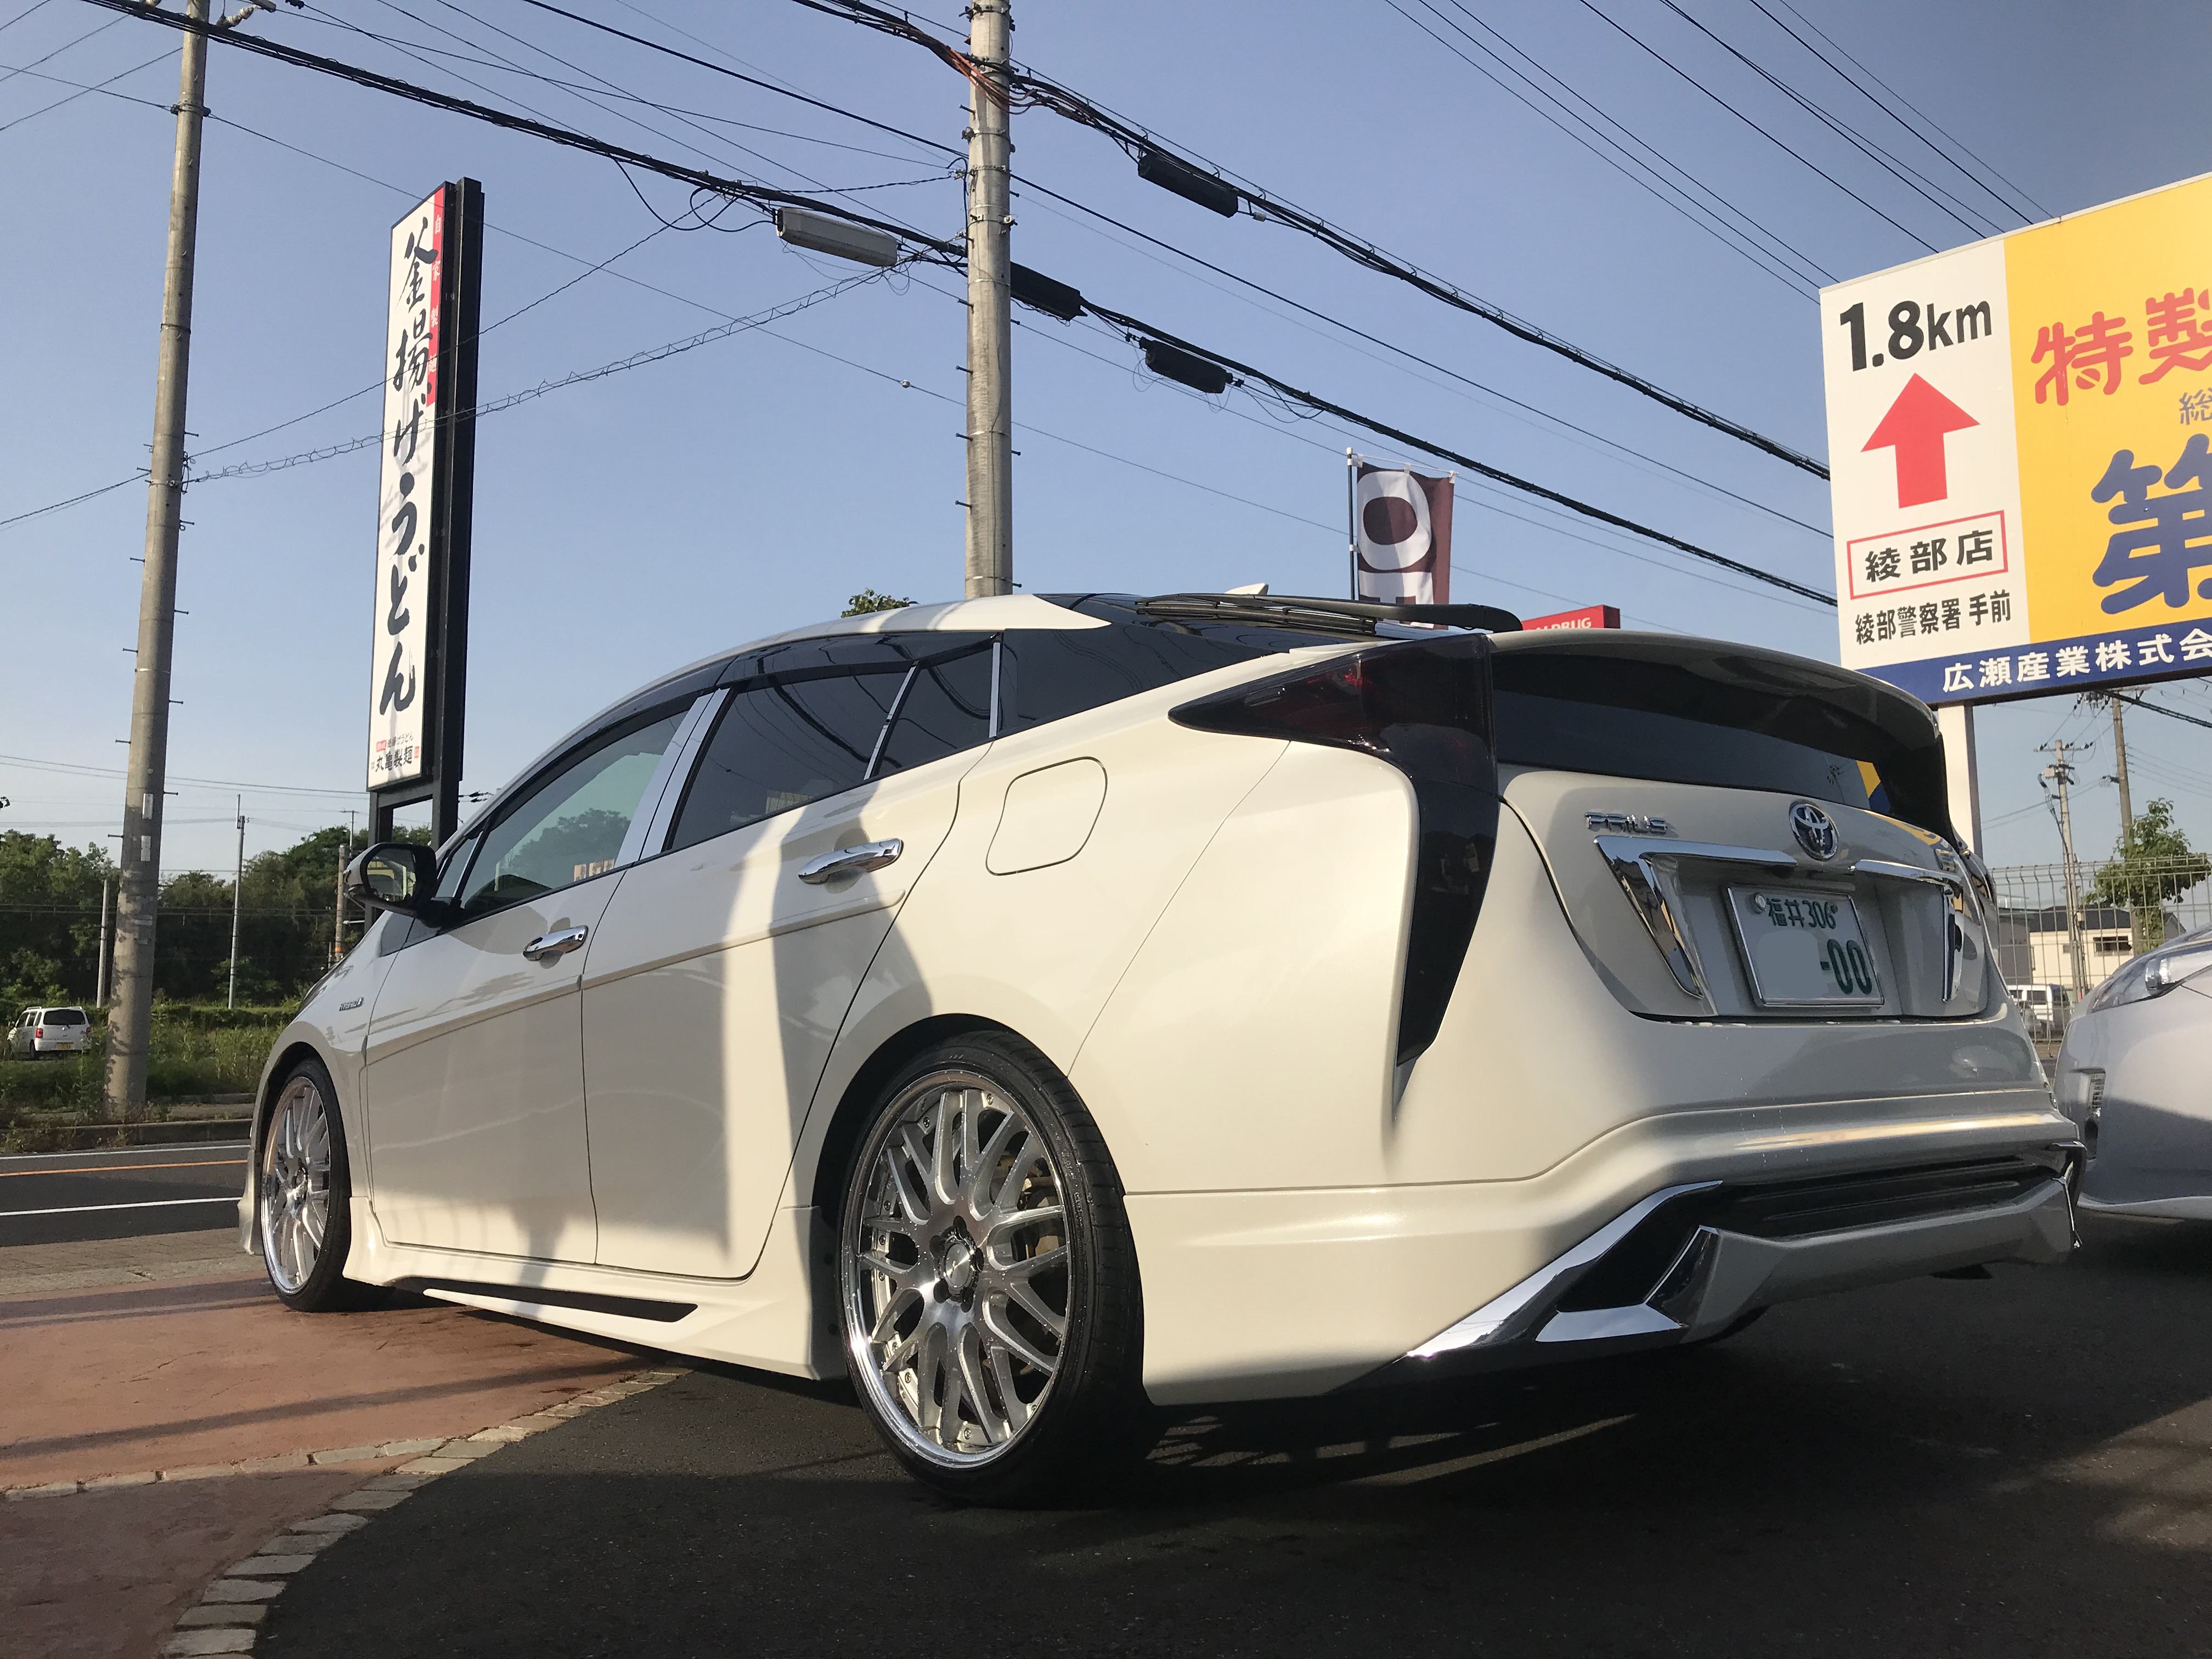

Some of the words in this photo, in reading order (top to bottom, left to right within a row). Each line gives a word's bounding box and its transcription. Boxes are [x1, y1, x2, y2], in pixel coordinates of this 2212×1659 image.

[1839, 300, 1993, 371] 1.8km
[2031, 287, 2212, 406] 特製
[379, 217, 438, 715] 釜揚げうどん
[1865, 530, 1993, 582] 綾部店
[1942, 628, 2212, 693] 広瀬産業株式会
[375, 746, 413, 772] 丸亀製麺
